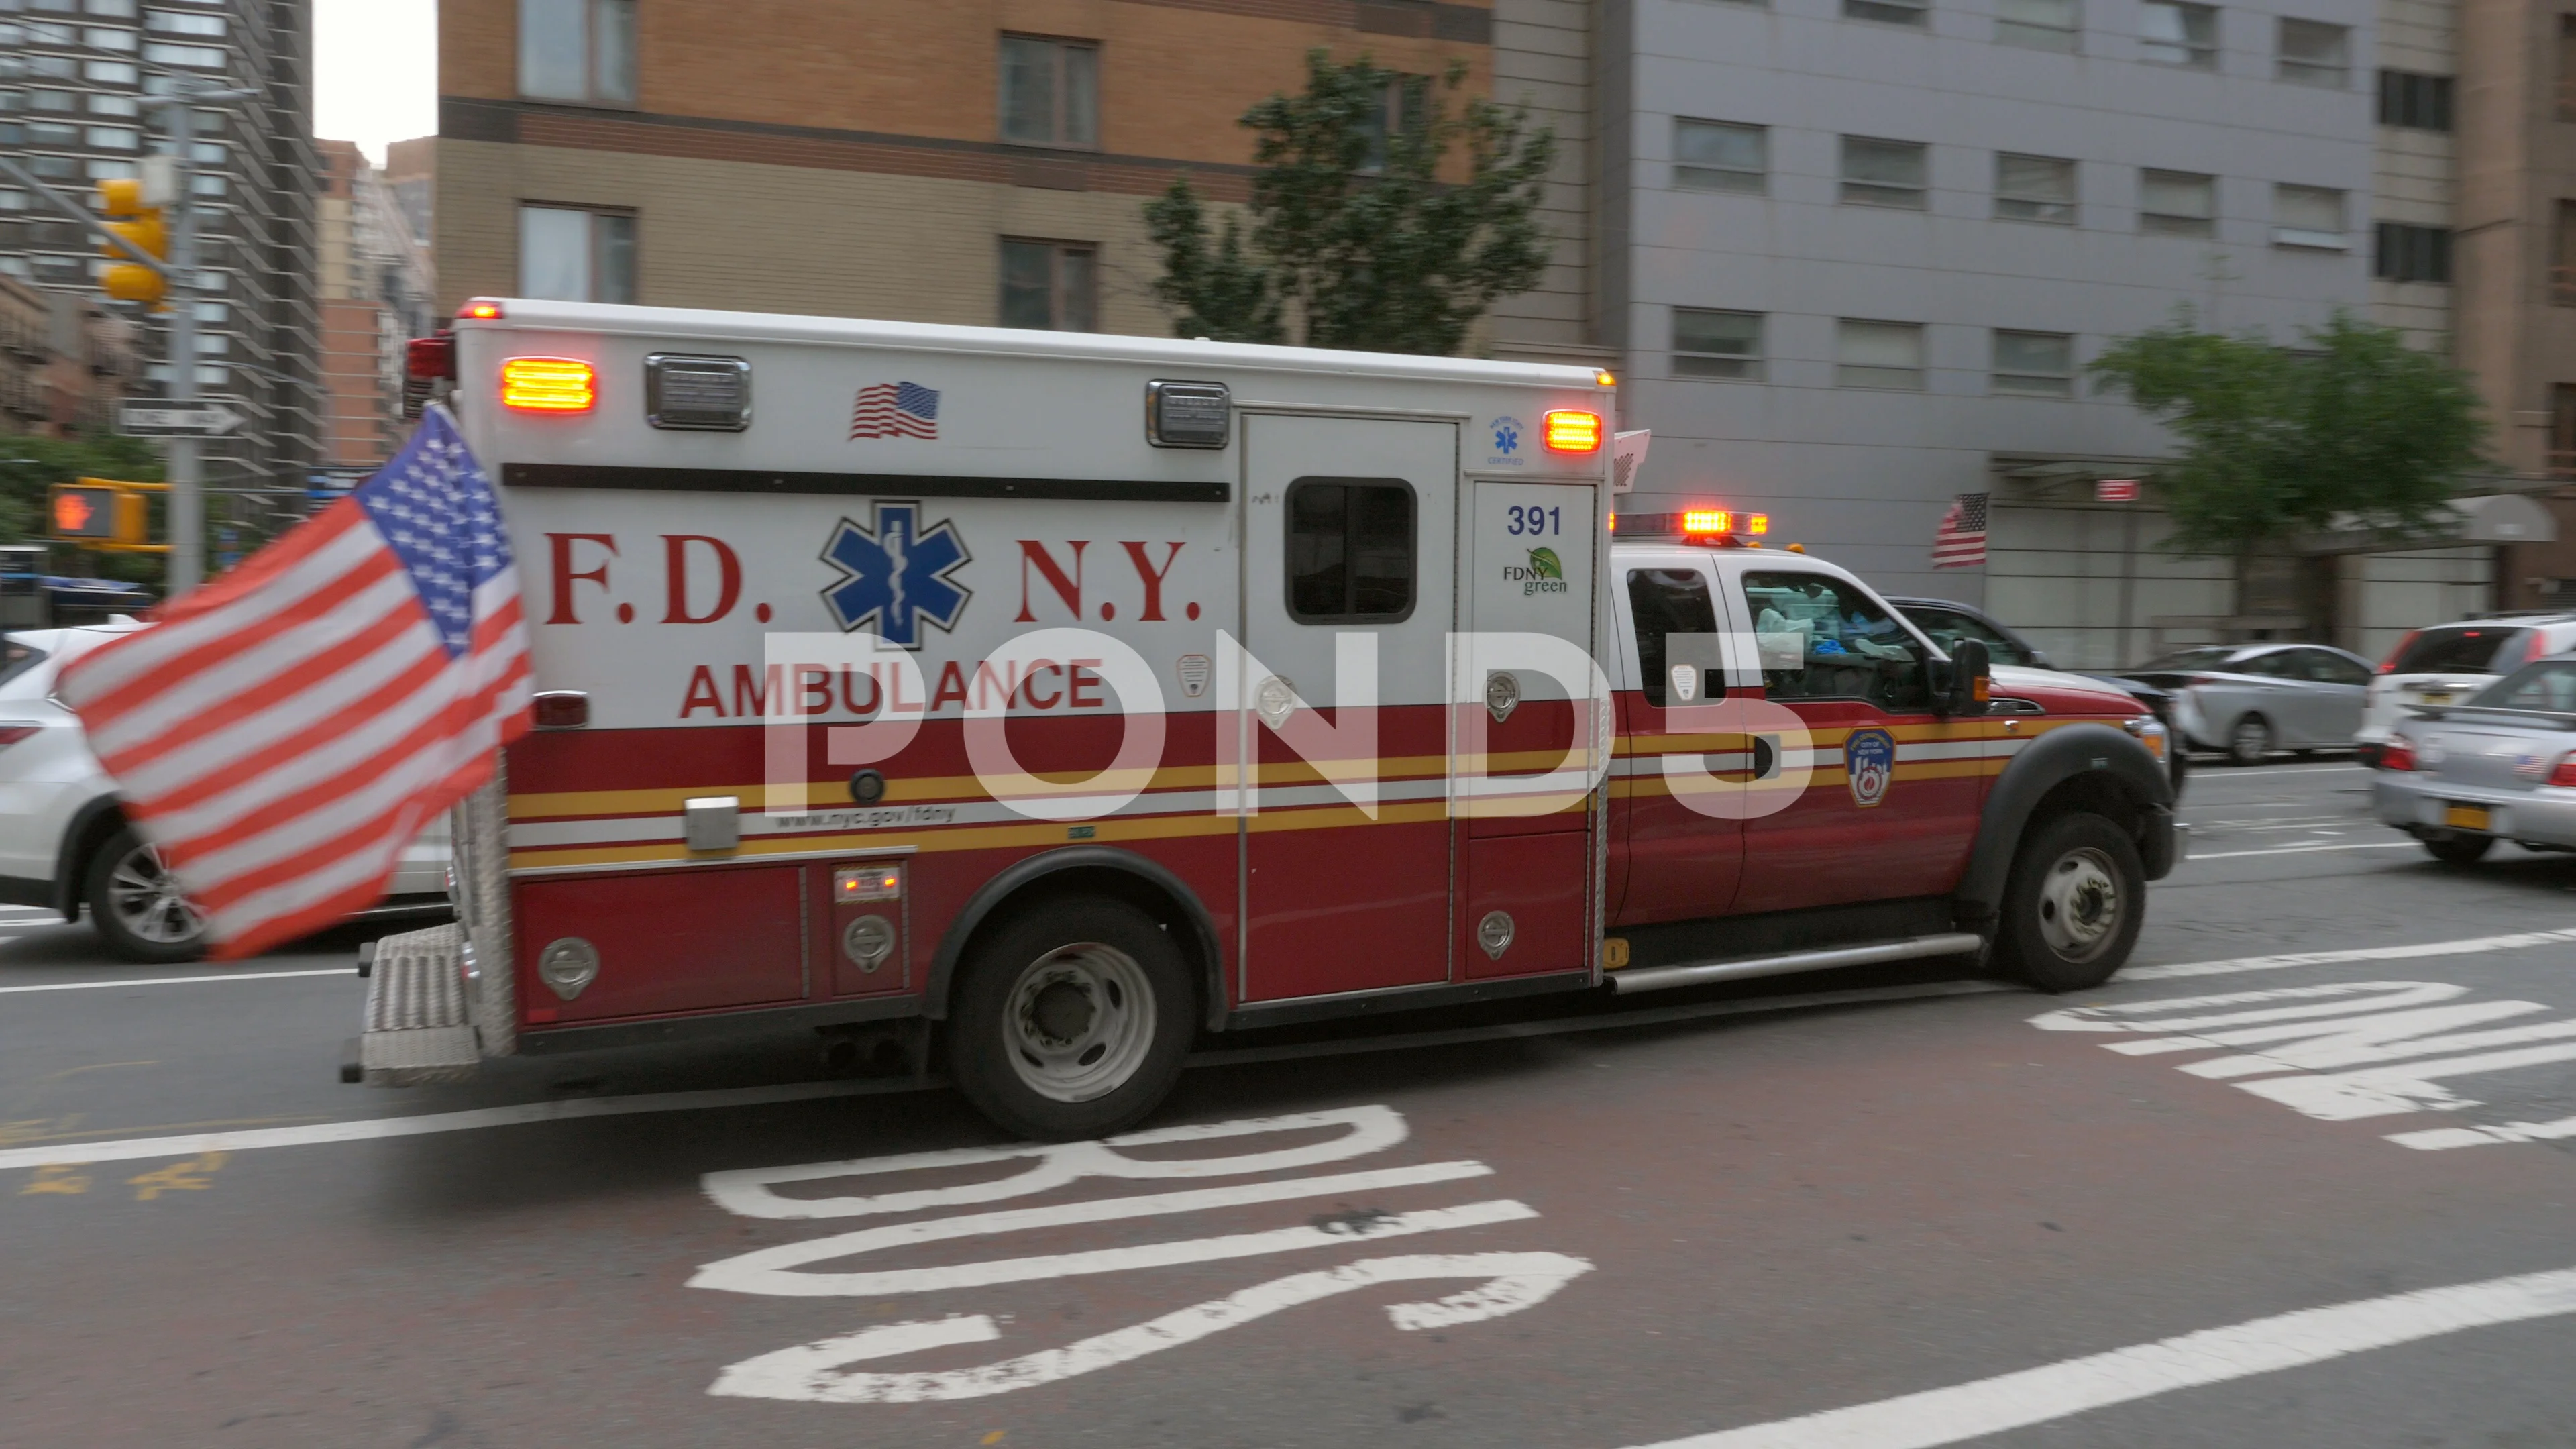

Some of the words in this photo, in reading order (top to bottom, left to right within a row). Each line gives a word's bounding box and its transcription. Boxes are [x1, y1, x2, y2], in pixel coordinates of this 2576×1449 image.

[1488, 457, 1524, 466] CERTIFIED
[1507, 506, 1560, 535] 391
[1503, 566, 1548, 580] FDNY
[1524, 581, 1567, 596] green
[678, 658, 1104, 719] AMBULANCE
[775, 806, 956, 828] www.nyc.gov/fdny
[685, 1104, 1596, 1403] BUS
